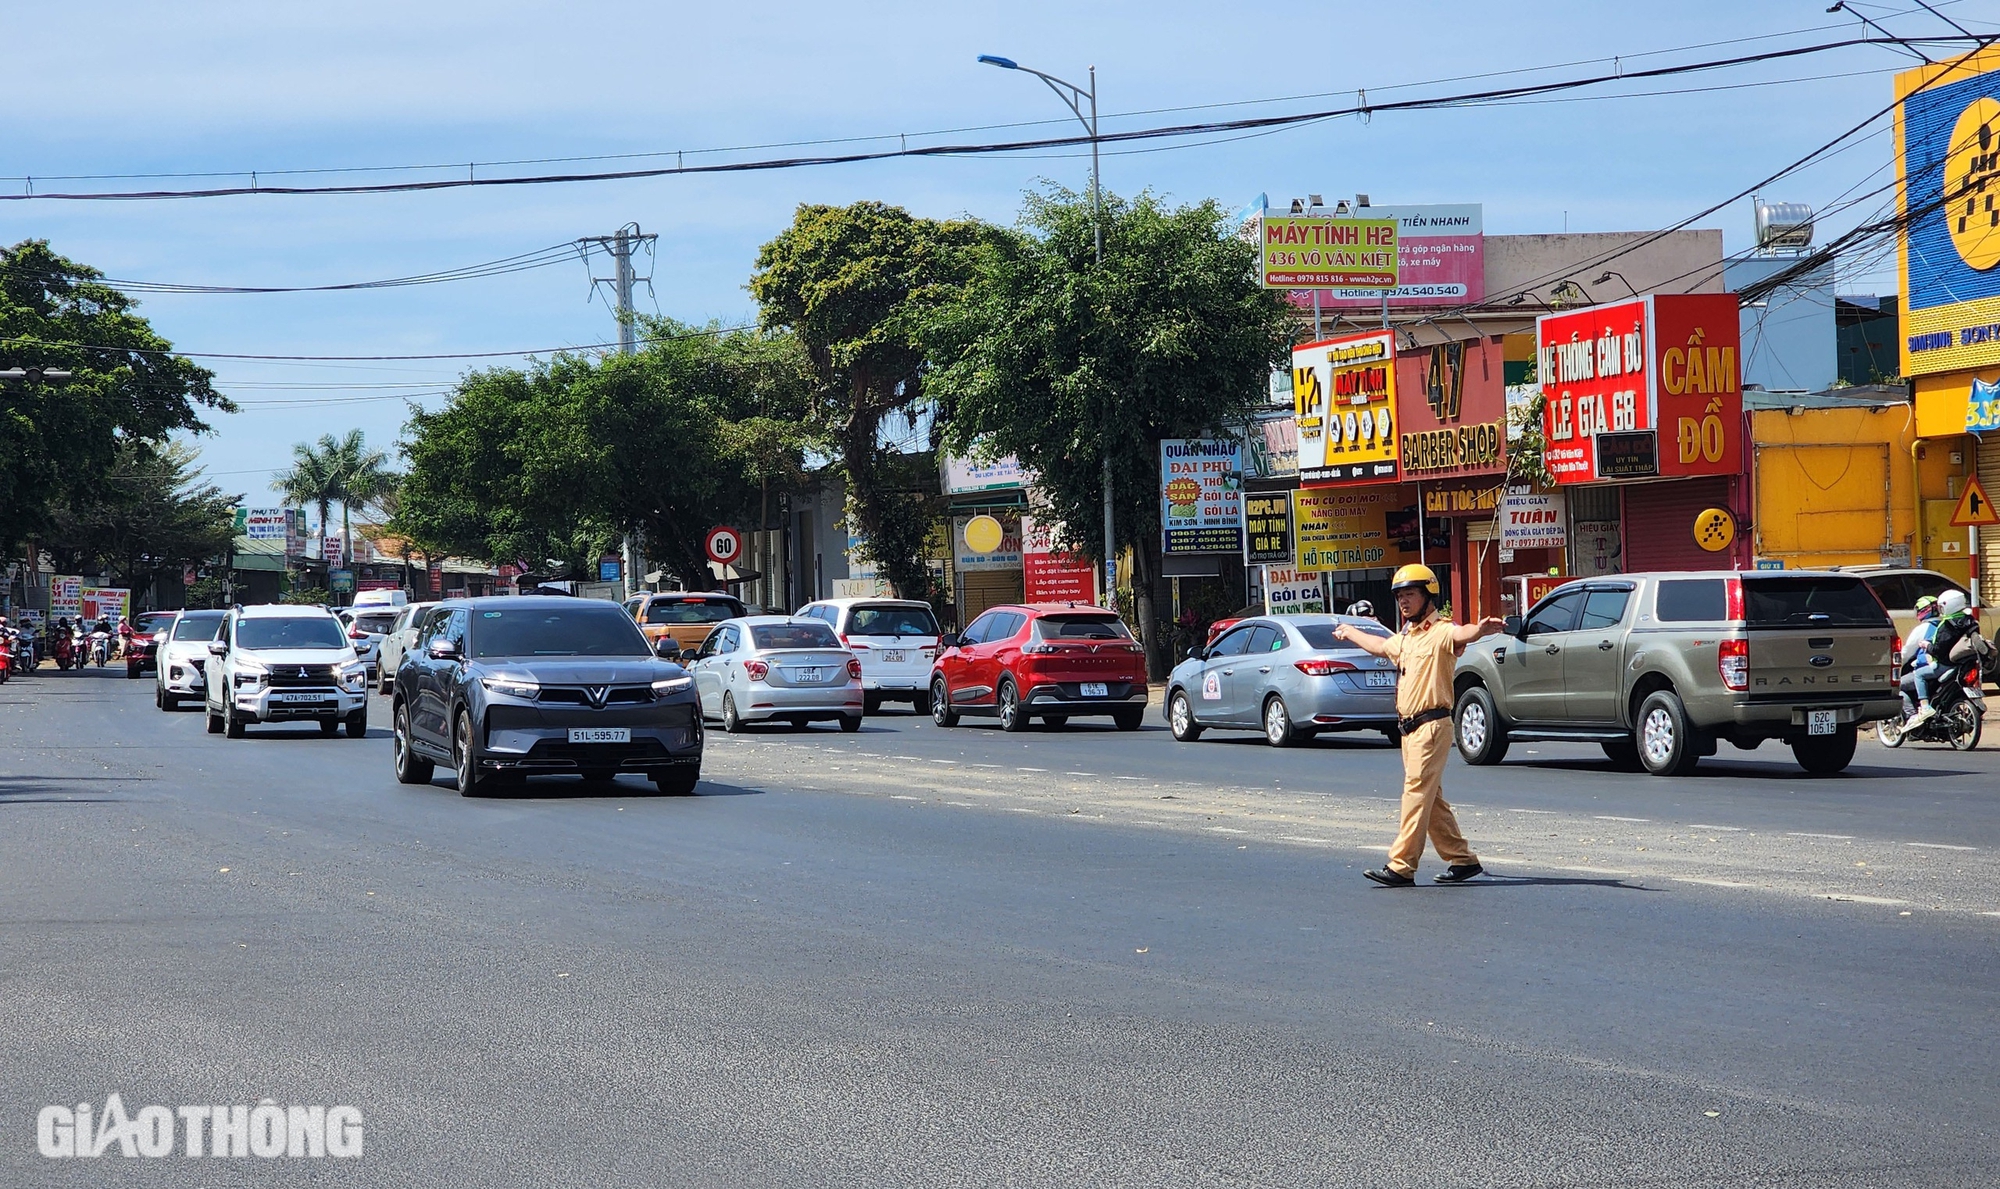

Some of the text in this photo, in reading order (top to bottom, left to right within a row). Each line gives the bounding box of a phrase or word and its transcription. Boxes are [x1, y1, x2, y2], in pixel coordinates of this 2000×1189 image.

[1403, 213, 1470, 227] TIỀN NHANH
[1267, 221, 1394, 245] MÁY TÍNH H2
[1412, 244, 1428, 254] góp
[1430, 244, 1451, 254] ngân
[1454, 243, 1475, 253] hàng
[1268, 247, 1393, 270] 436 VÕ VĂN KIỆT
[1423, 257, 1441, 267] máy
[1297, 275, 1314, 283] 0979
[1316, 275, 1329, 283] 815
[1331, 275, 1344, 283] 816
[1340, 288, 1377, 297] Hotline:
[1908, 323, 2000, 353] SAMSUNG SONY
[1542, 341, 1556, 389] HỆ
[1558, 331, 1593, 383] THỐNG
[1662, 327, 1736, 395] CẦM
[1426, 340, 1464, 420] 47
[1551, 391, 1573, 440] LÊ
[1577, 392, 1609, 438] GIA
[1612, 390, 1636, 431] 68
[1677, 396, 1725, 464] ĐỒ
[1402, 430, 1455, 470] BARBER
[1458, 423, 1499, 467] SHOP
[1170, 459, 1233, 475] ĐẠI PHÚ
[1225, 489, 1239, 500] CÁ
[1300, 497, 1319, 506] THU
[1426, 481, 1449, 512] CẮT
[1451, 484, 1476, 511] TÓC
[1528, 496, 1548, 505] GIÀY
[1225, 504, 1238, 515] LÁ
[1184, 518, 1197, 526] SƠN
[1221, 516, 1238, 525] BÌNH
[1249, 516, 1286, 533] MÁY TÍNH
[716, 538, 731, 553] 60
[1255, 532, 1281, 550] GIÁ RẺ
[1303, 545, 1384, 567] HỖ TRỢ TRẢ GÓP
[1271, 569, 1292, 586] ĐẠI
[1271, 586, 1321, 602] GỎI CÁ
[1755, 674, 1886, 686] RANGER
[1814, 712, 1830, 723] 62C
[573, 731, 626, 741] 51L-595.77
[1810, 723, 1836, 734] 105.15
